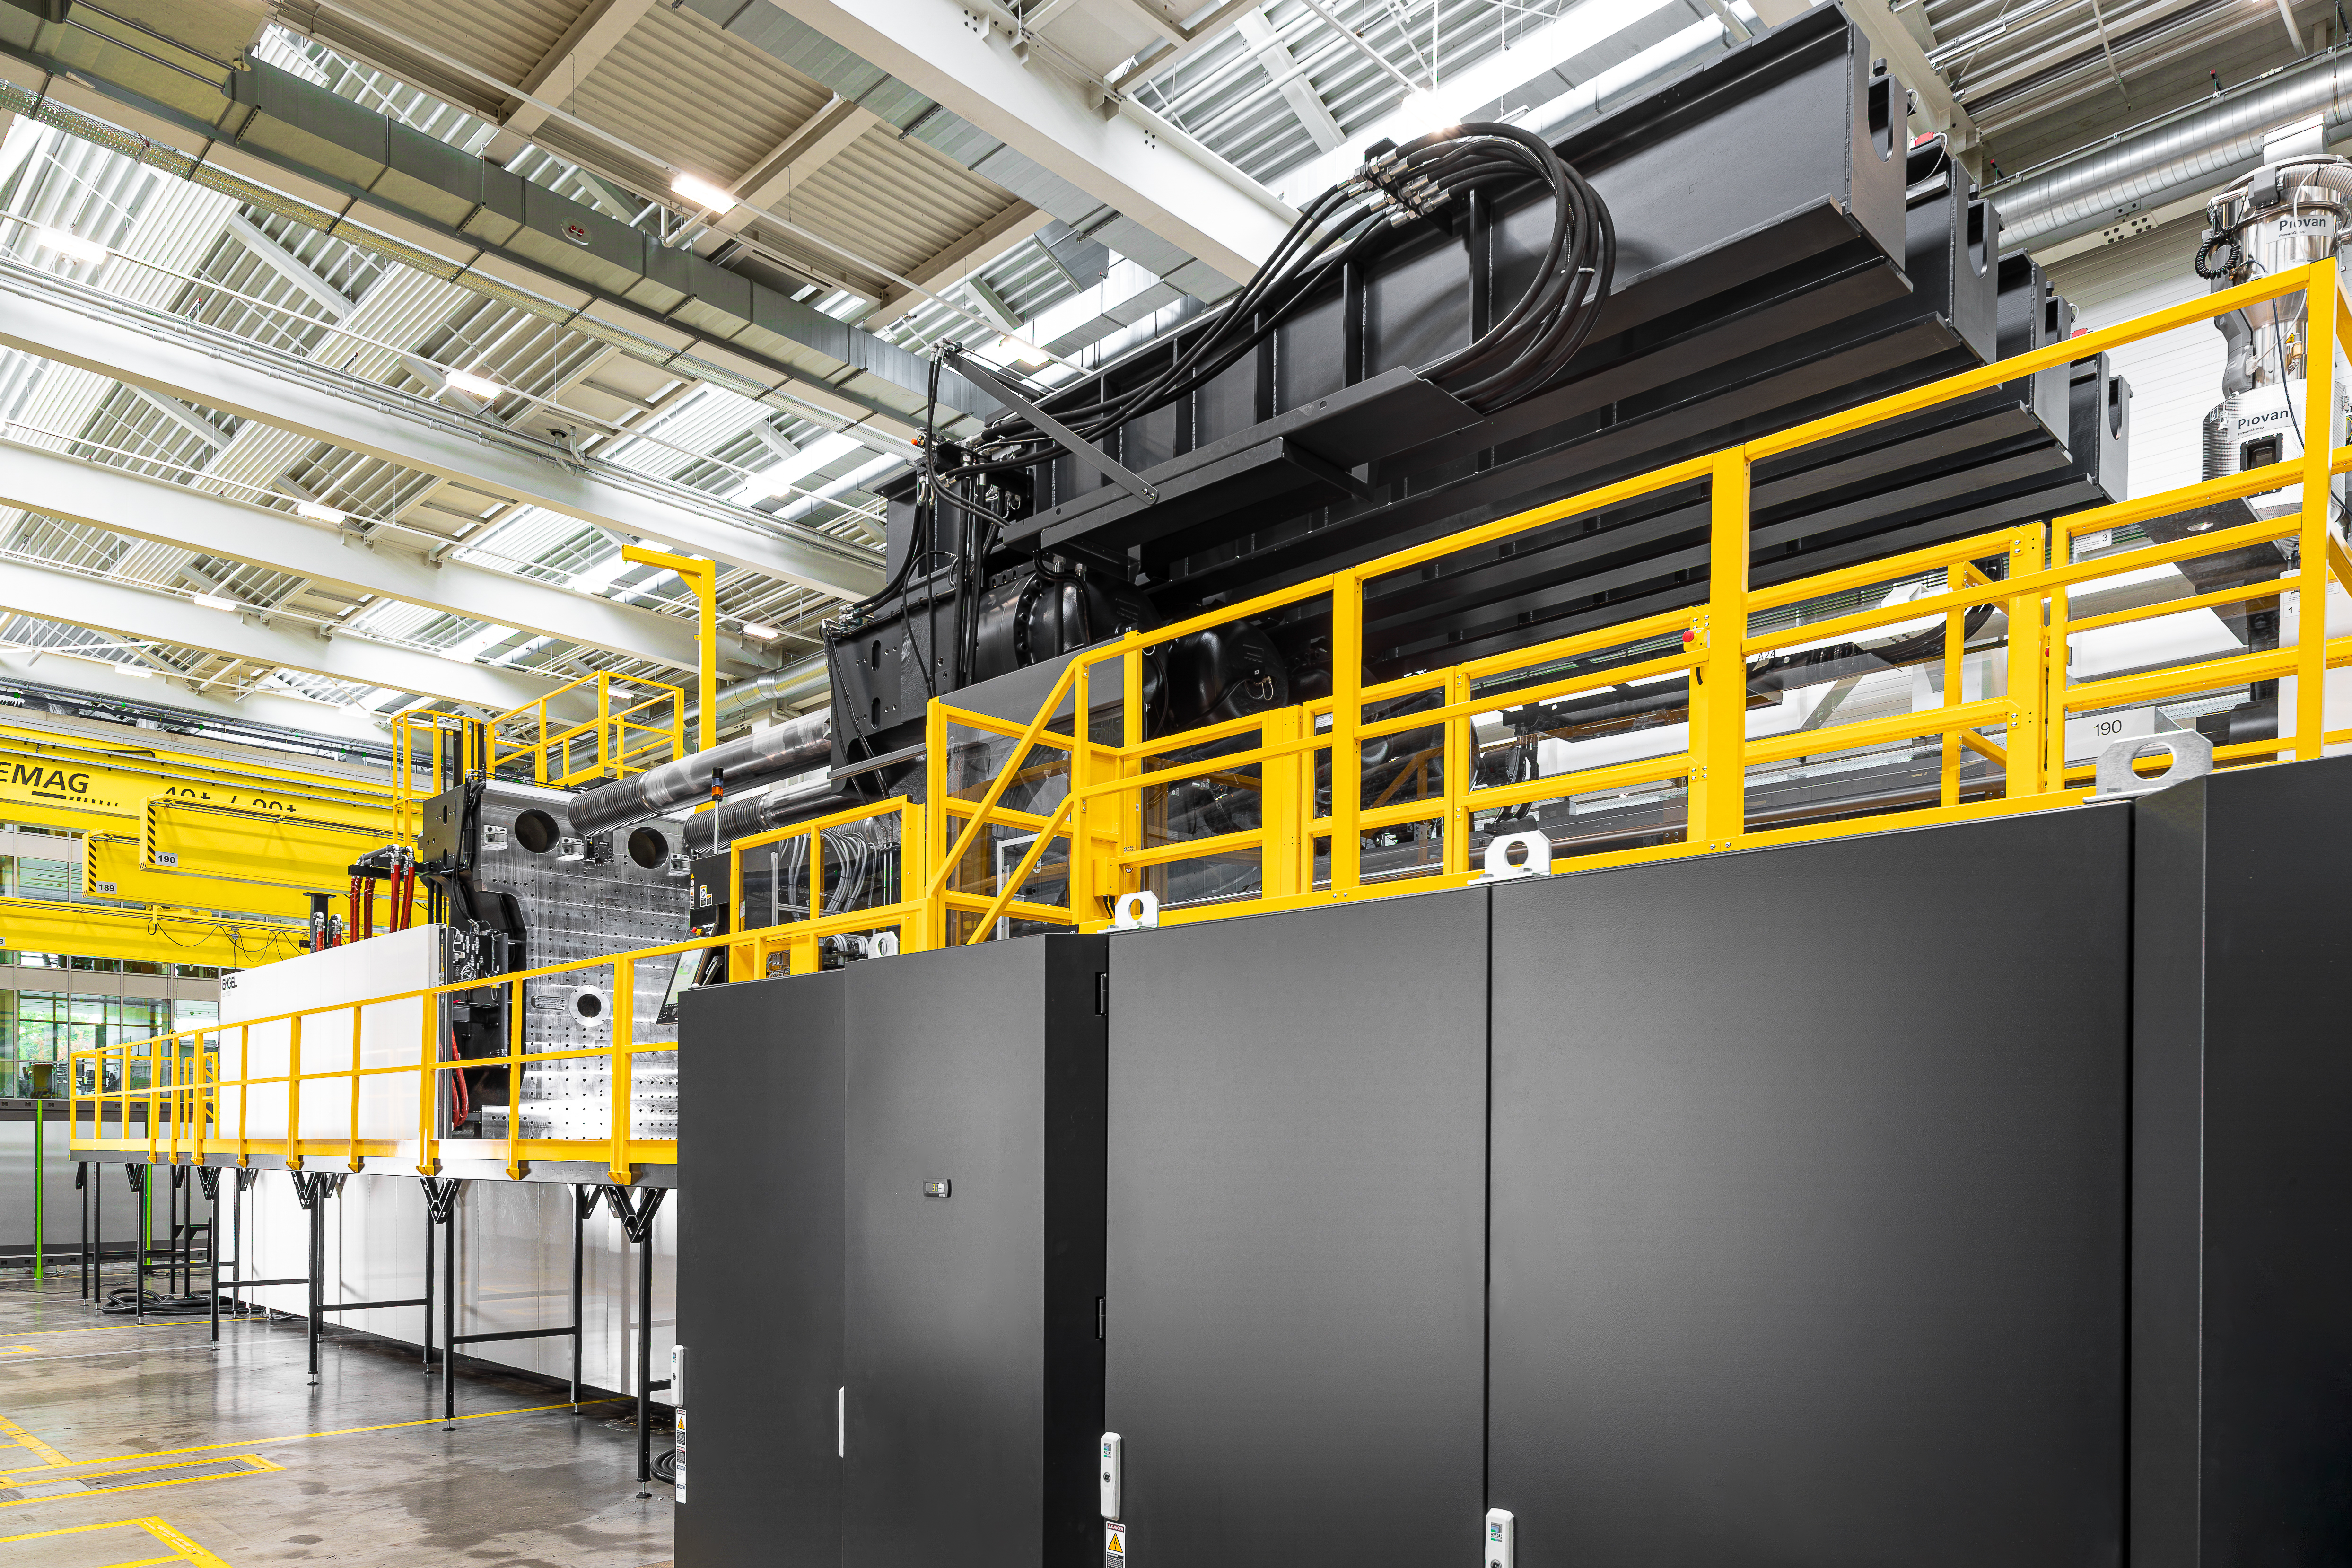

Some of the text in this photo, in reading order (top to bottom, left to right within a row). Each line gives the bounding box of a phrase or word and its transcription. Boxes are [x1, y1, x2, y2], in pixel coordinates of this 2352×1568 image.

[2279, 219, 2326, 231] Piovan
[2238, 410, 2289, 430] Piovan
[2093, 720, 2122, 736] 190
[158, 855, 175, 863] 190
[222, 976, 237, 990] ENGEL
